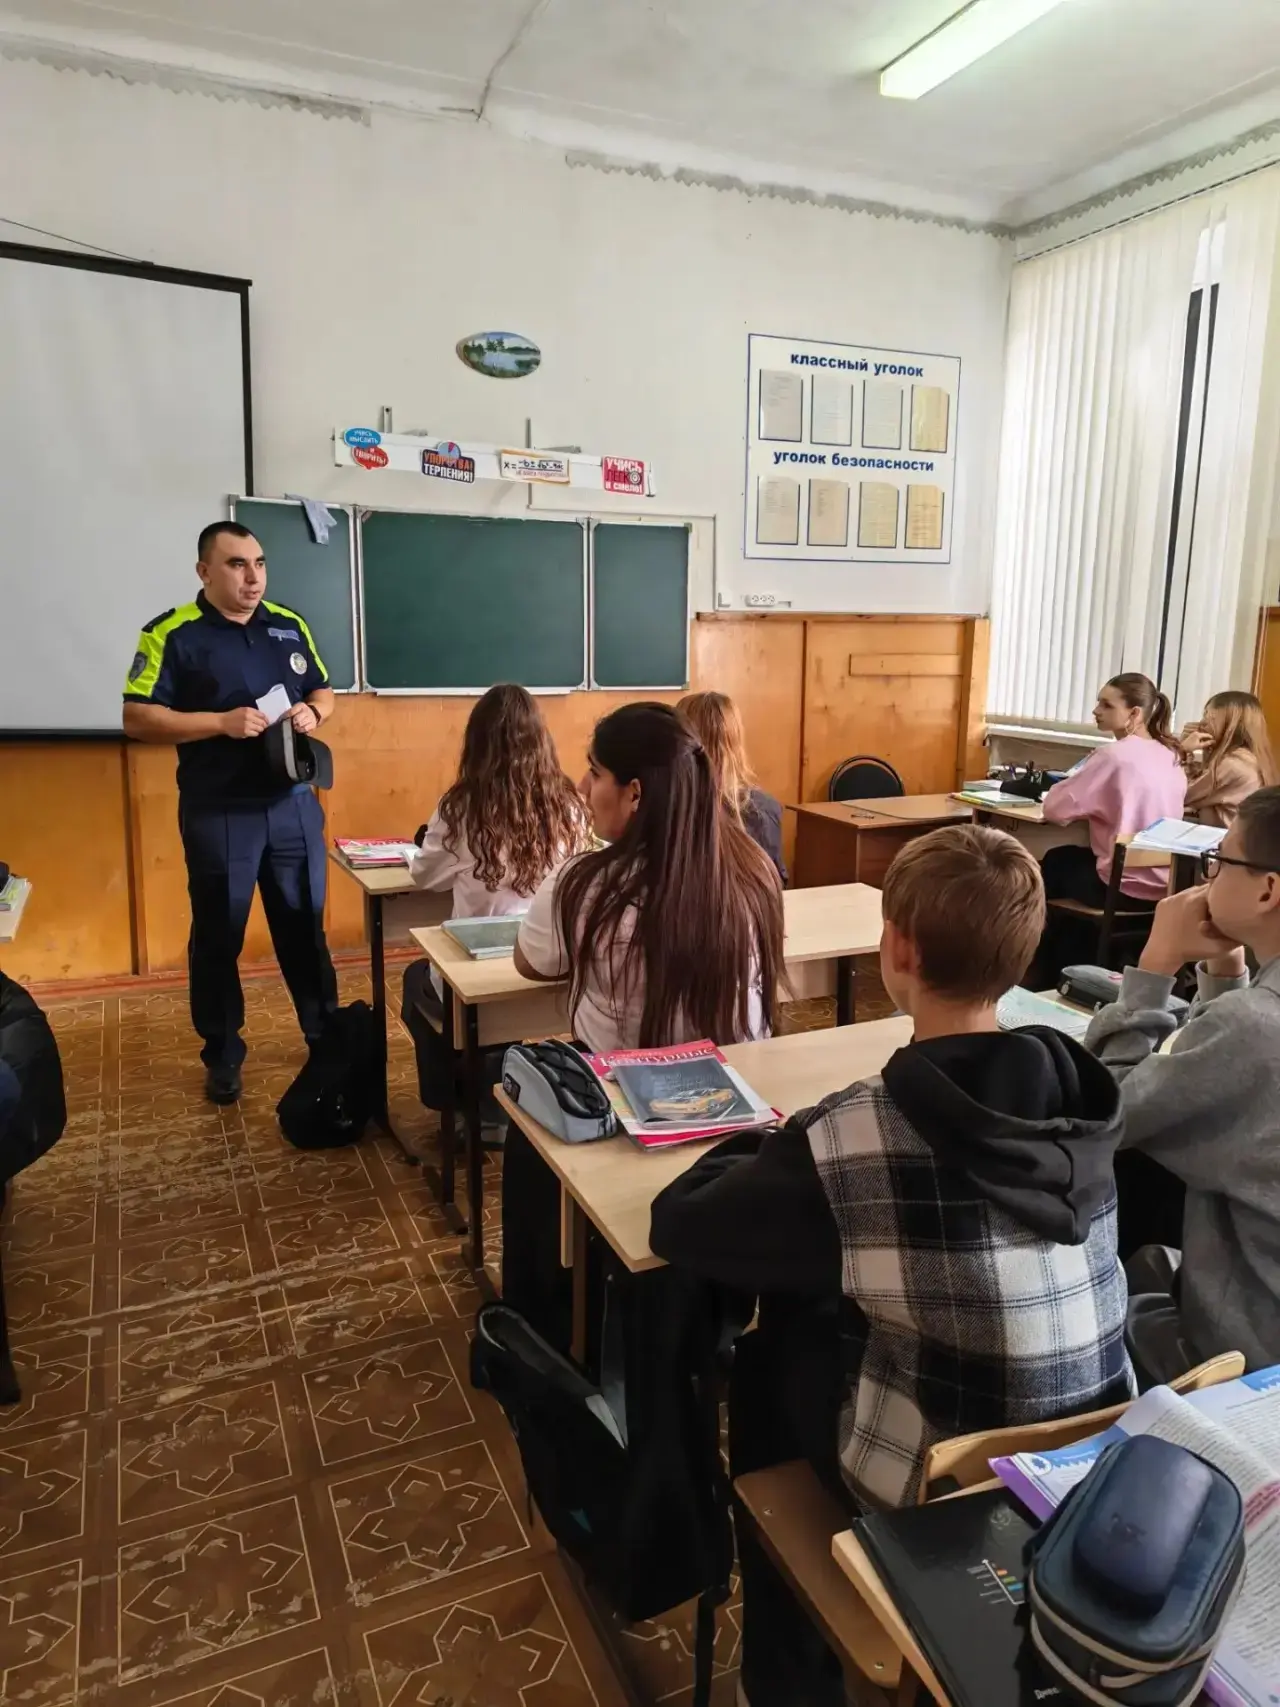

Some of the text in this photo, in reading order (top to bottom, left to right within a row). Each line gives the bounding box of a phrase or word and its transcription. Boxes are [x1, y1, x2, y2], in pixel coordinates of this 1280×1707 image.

[790, 353, 923, 377] классный уголок
[606, 457, 643, 474] УЧИСЬ
[773, 451, 934, 472] уголок безопасности
[424, 463, 473, 483] ТЕРПЕНИЯ!
